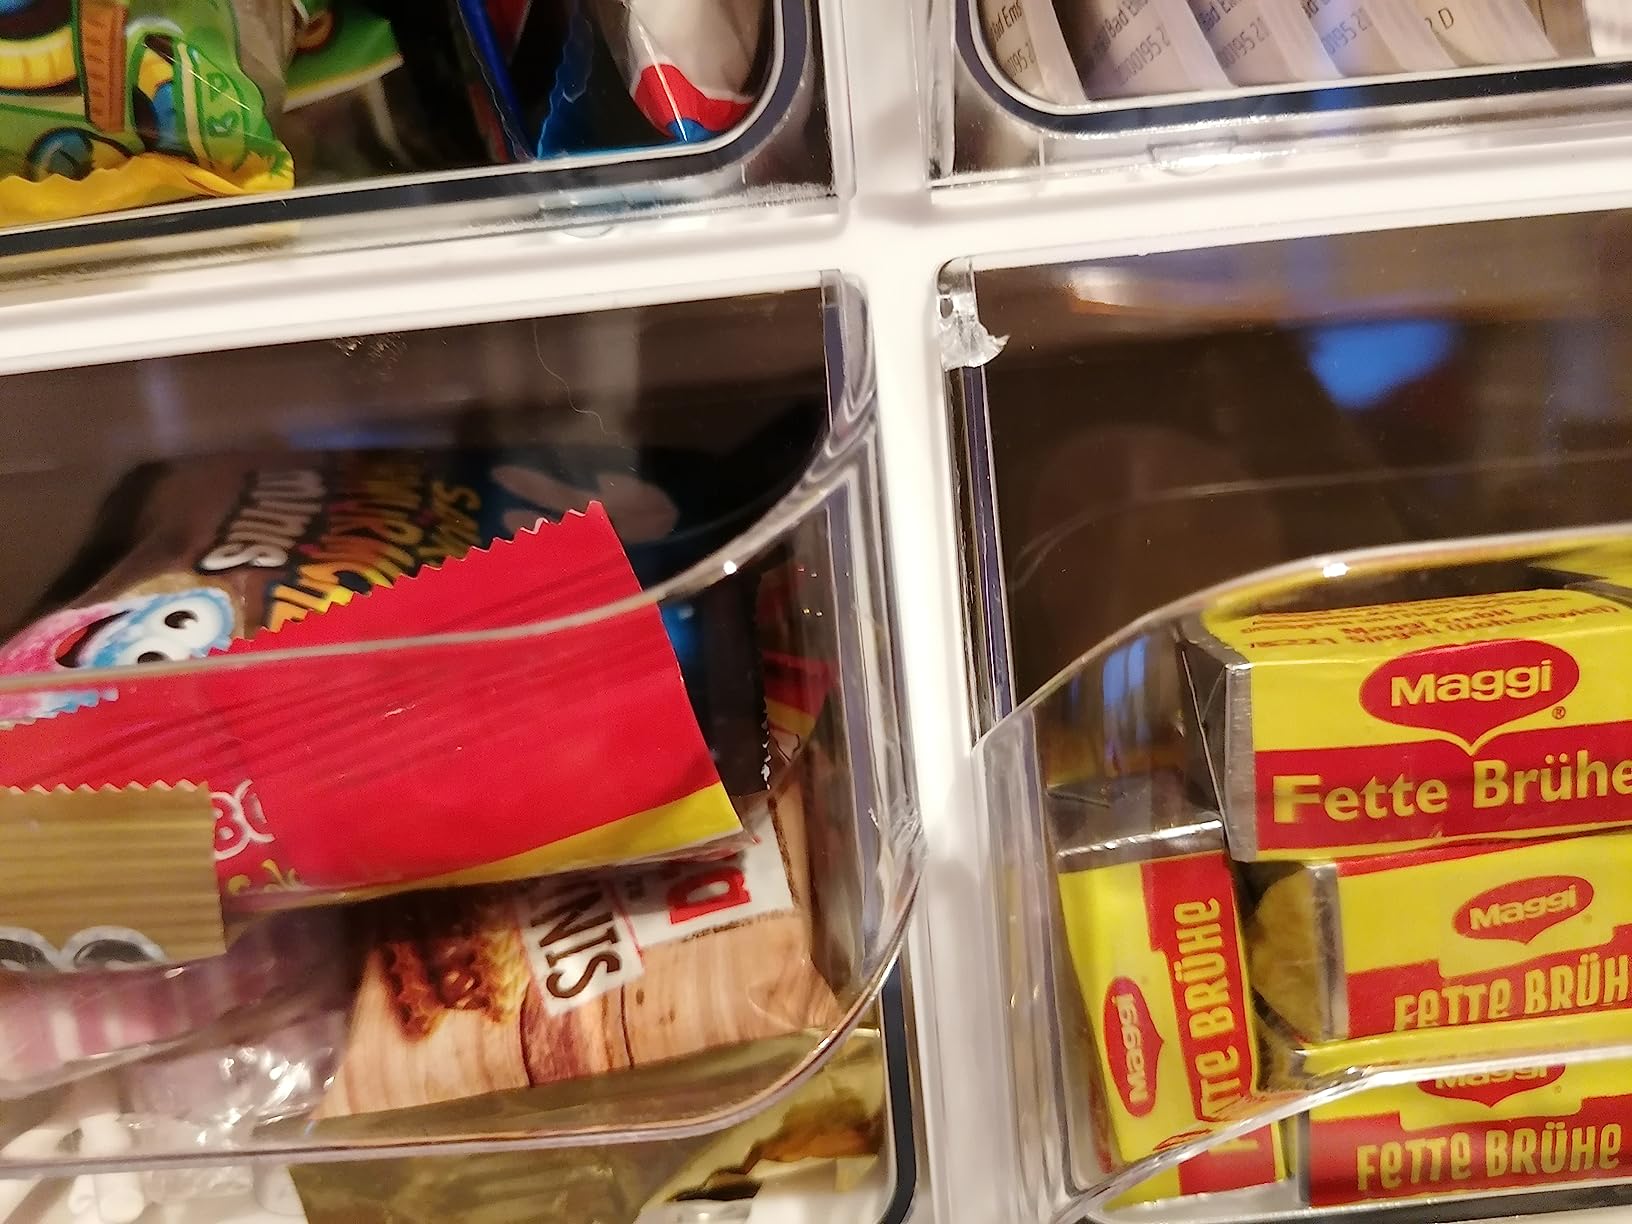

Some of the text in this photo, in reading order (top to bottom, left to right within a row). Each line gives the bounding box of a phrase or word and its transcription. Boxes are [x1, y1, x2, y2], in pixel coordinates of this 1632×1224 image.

[1437, 7, 1455, 30] D
[1391, 659, 1552, 707] Maggi
[1273, 750, 1632, 824] Fette Brühe
[1469, 884, 1577, 931] Maggi
[1110, 992, 1150, 1104] Maggi
